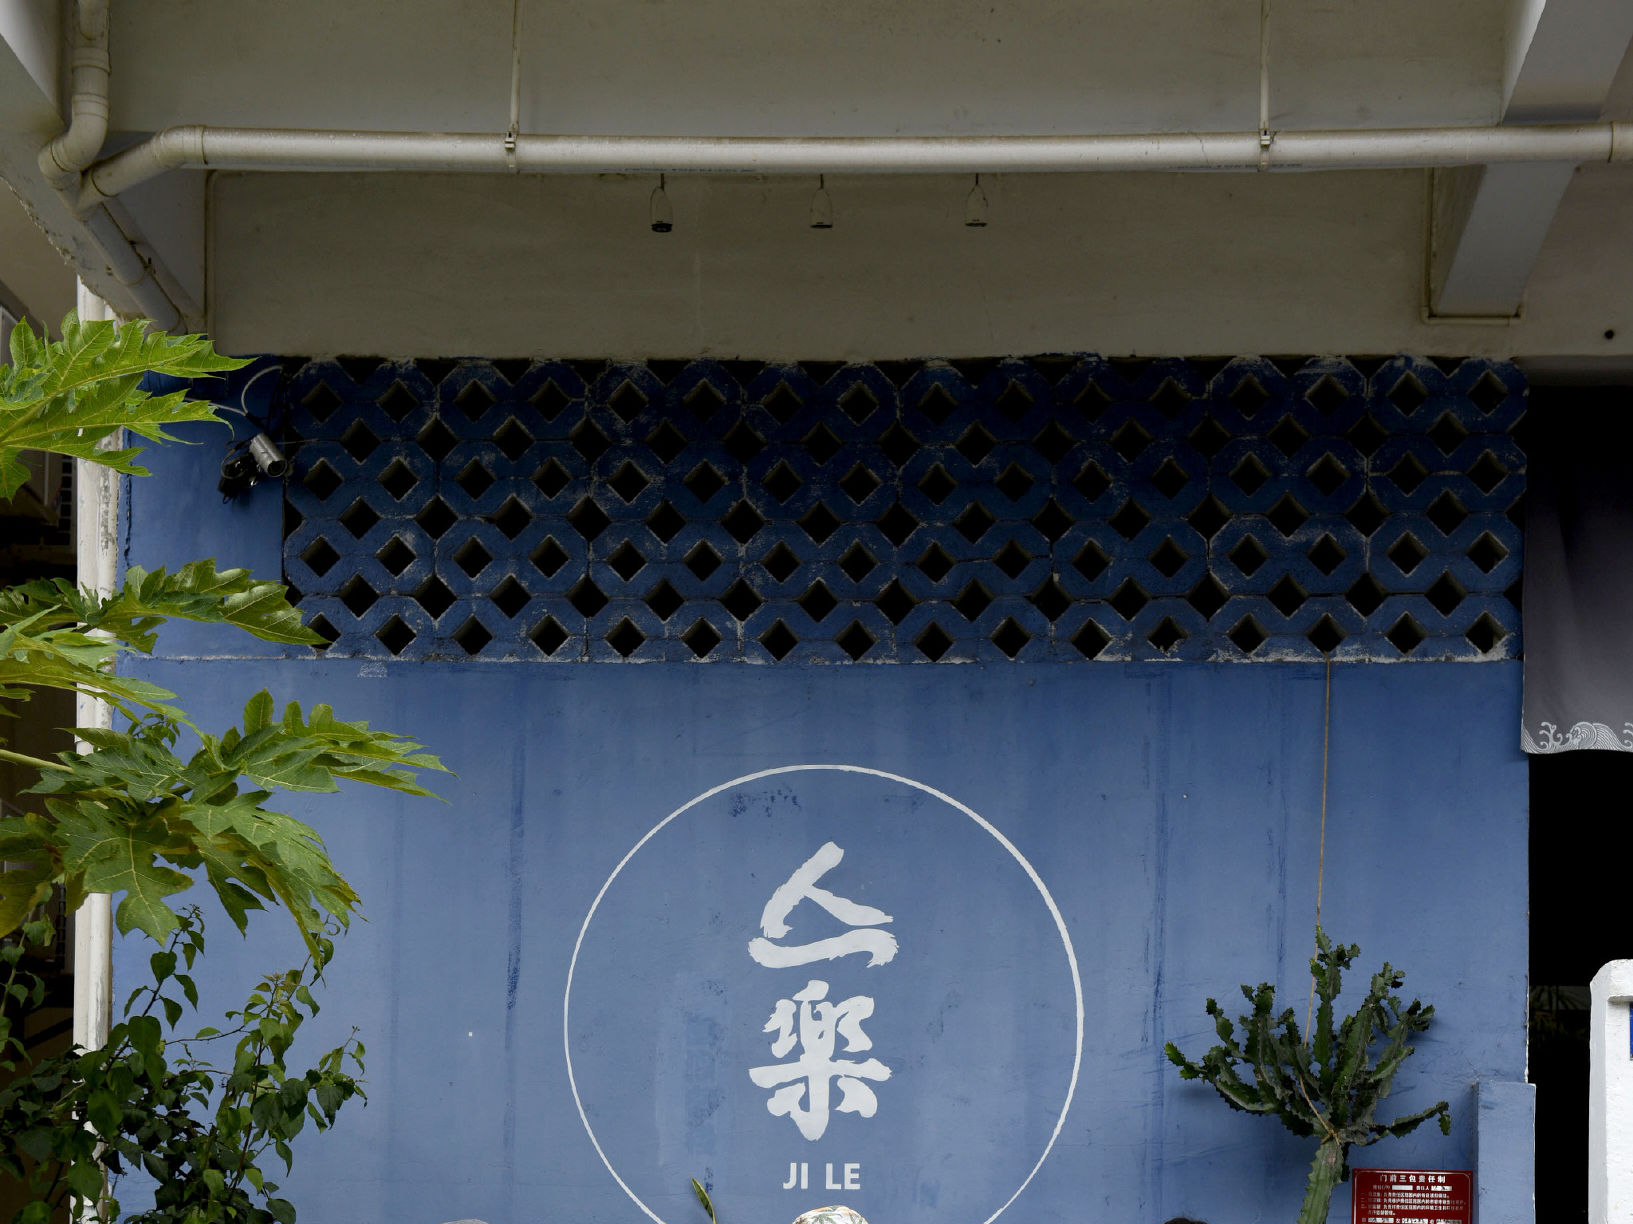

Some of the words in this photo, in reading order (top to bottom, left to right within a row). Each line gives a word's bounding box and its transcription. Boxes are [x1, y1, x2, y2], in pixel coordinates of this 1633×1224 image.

[782, 1162, 809, 1190] JI
[825, 1162, 861, 1190] LE
[1380, 1174, 1446, 1184] 门前三包责任制
